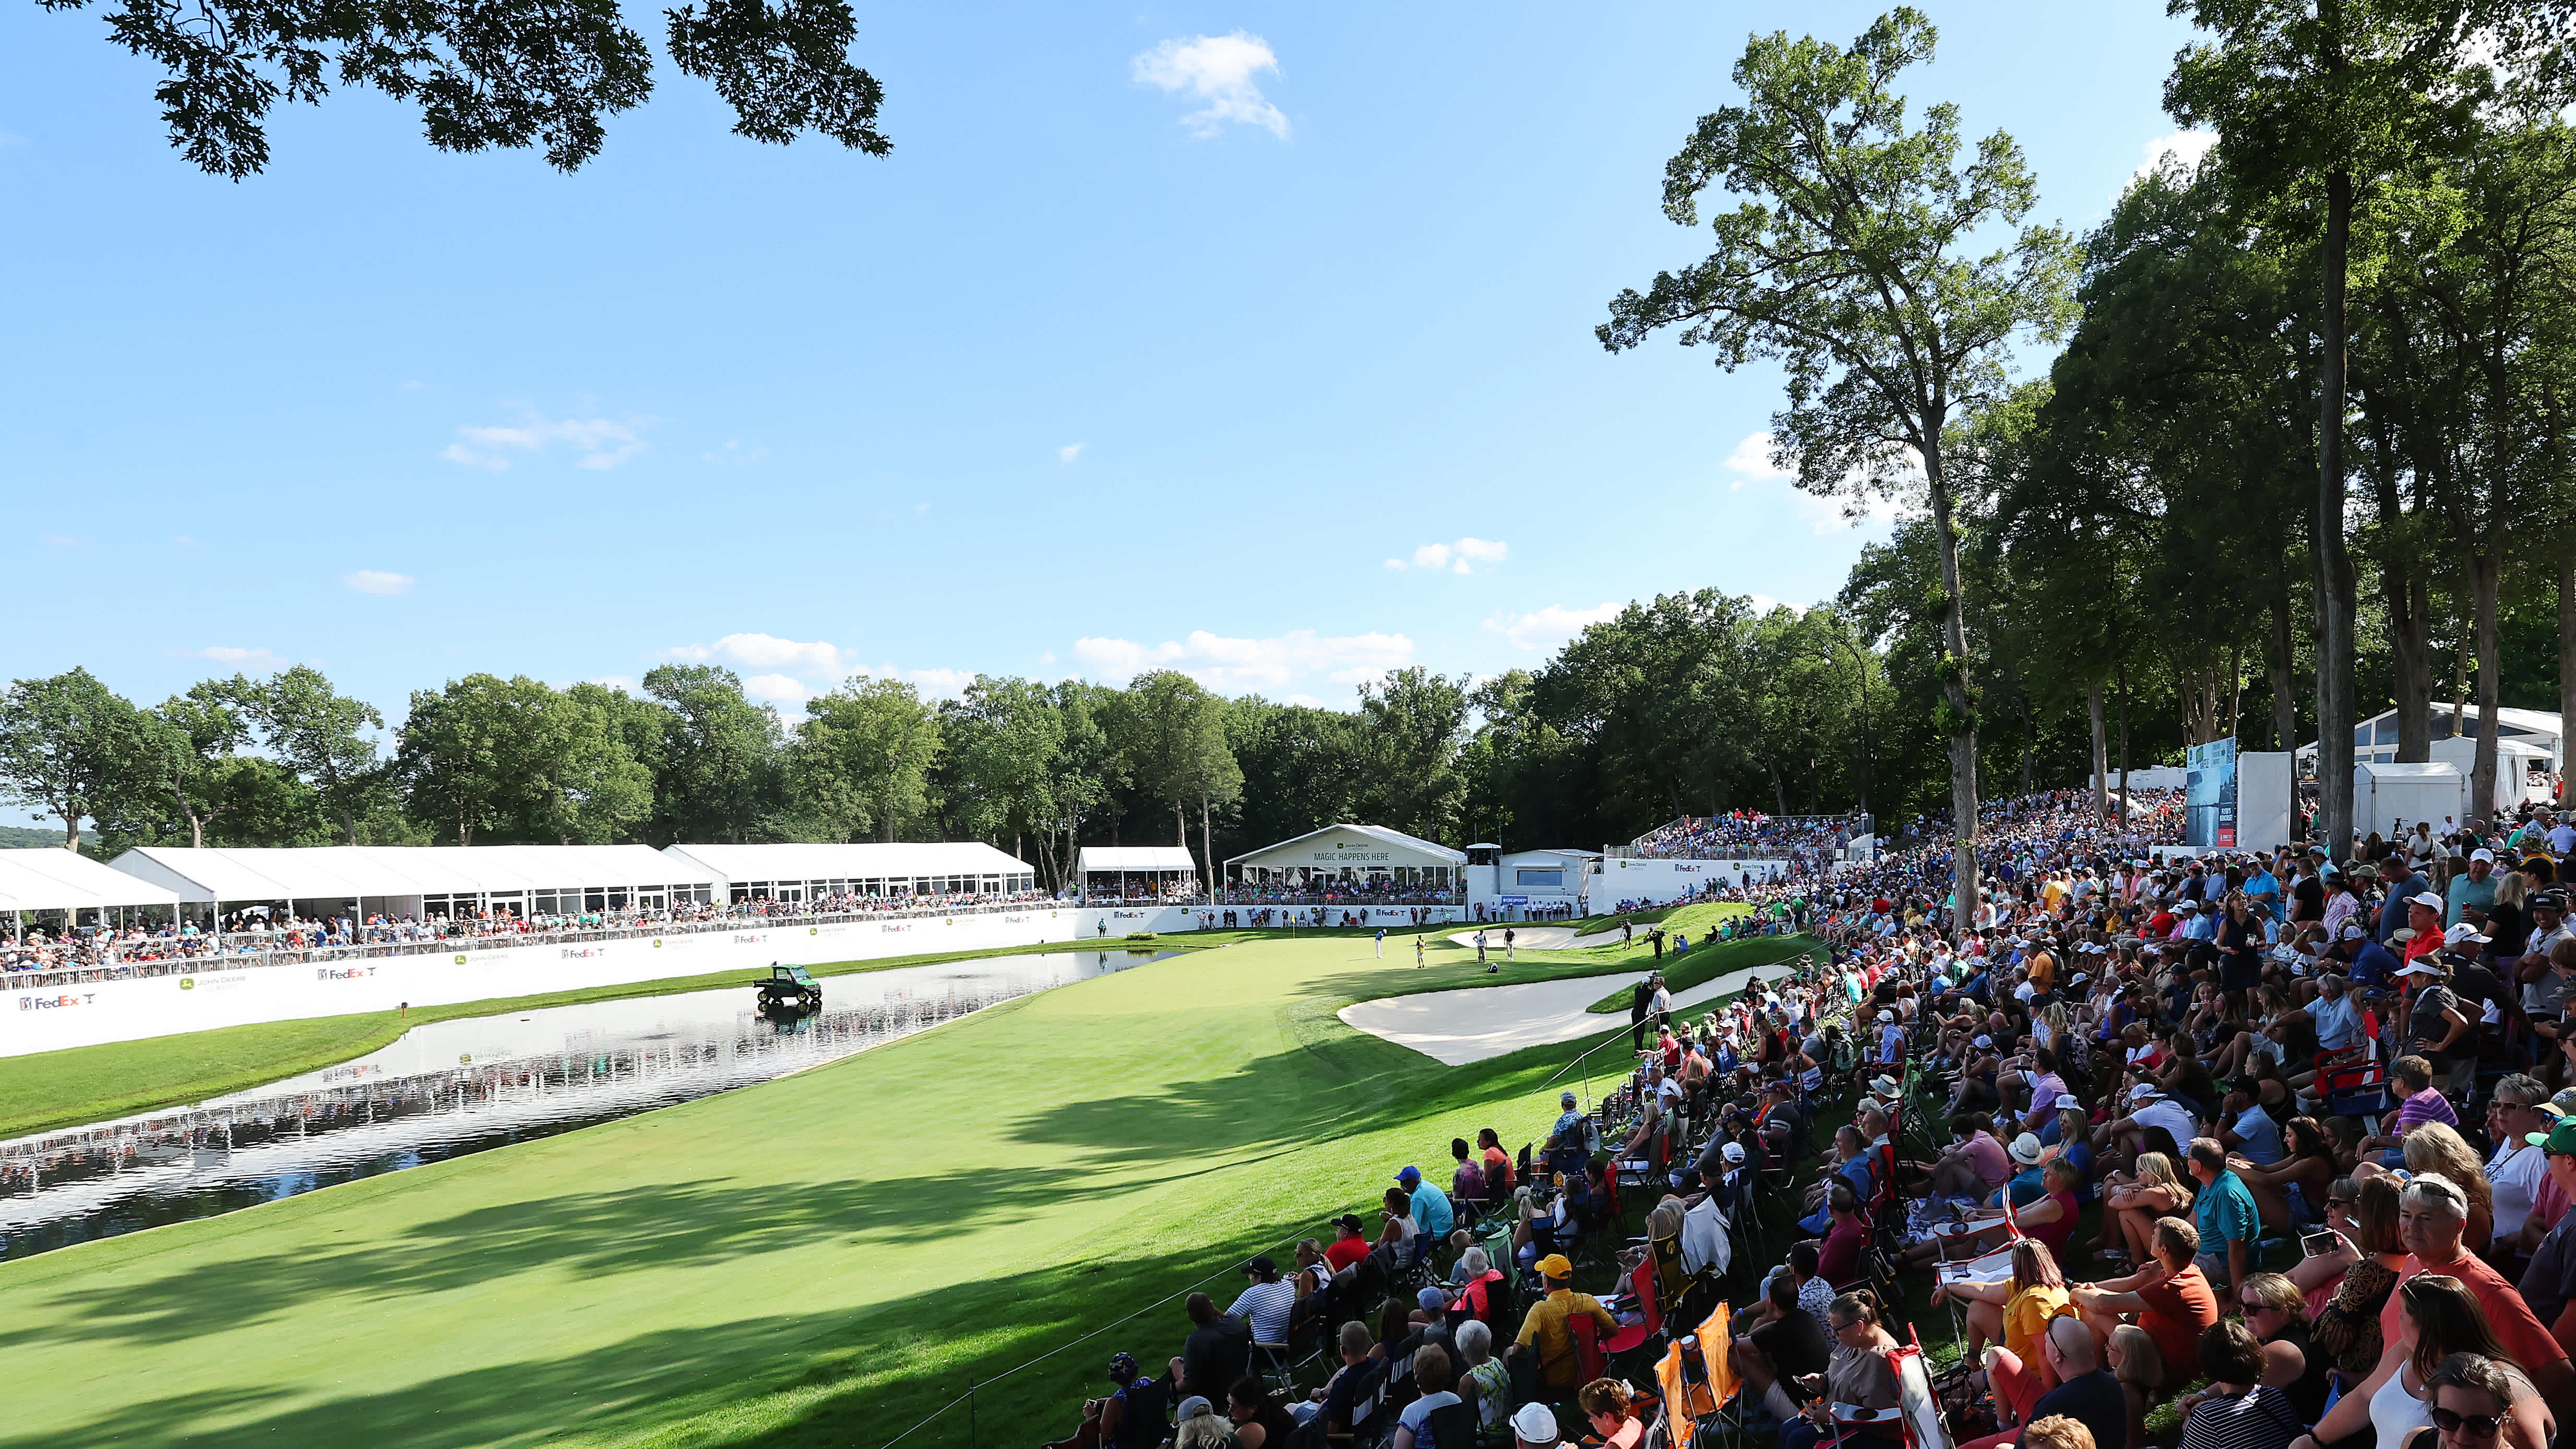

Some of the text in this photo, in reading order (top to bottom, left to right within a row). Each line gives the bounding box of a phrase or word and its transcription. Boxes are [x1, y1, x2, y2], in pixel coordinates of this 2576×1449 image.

[1314, 852, 1389, 861] MAGIC HAPPENS HERE
[570, 949, 595, 958] FedEx
[330, 968, 364, 979] FedEx
[35, 995, 79, 1010] FedEx
